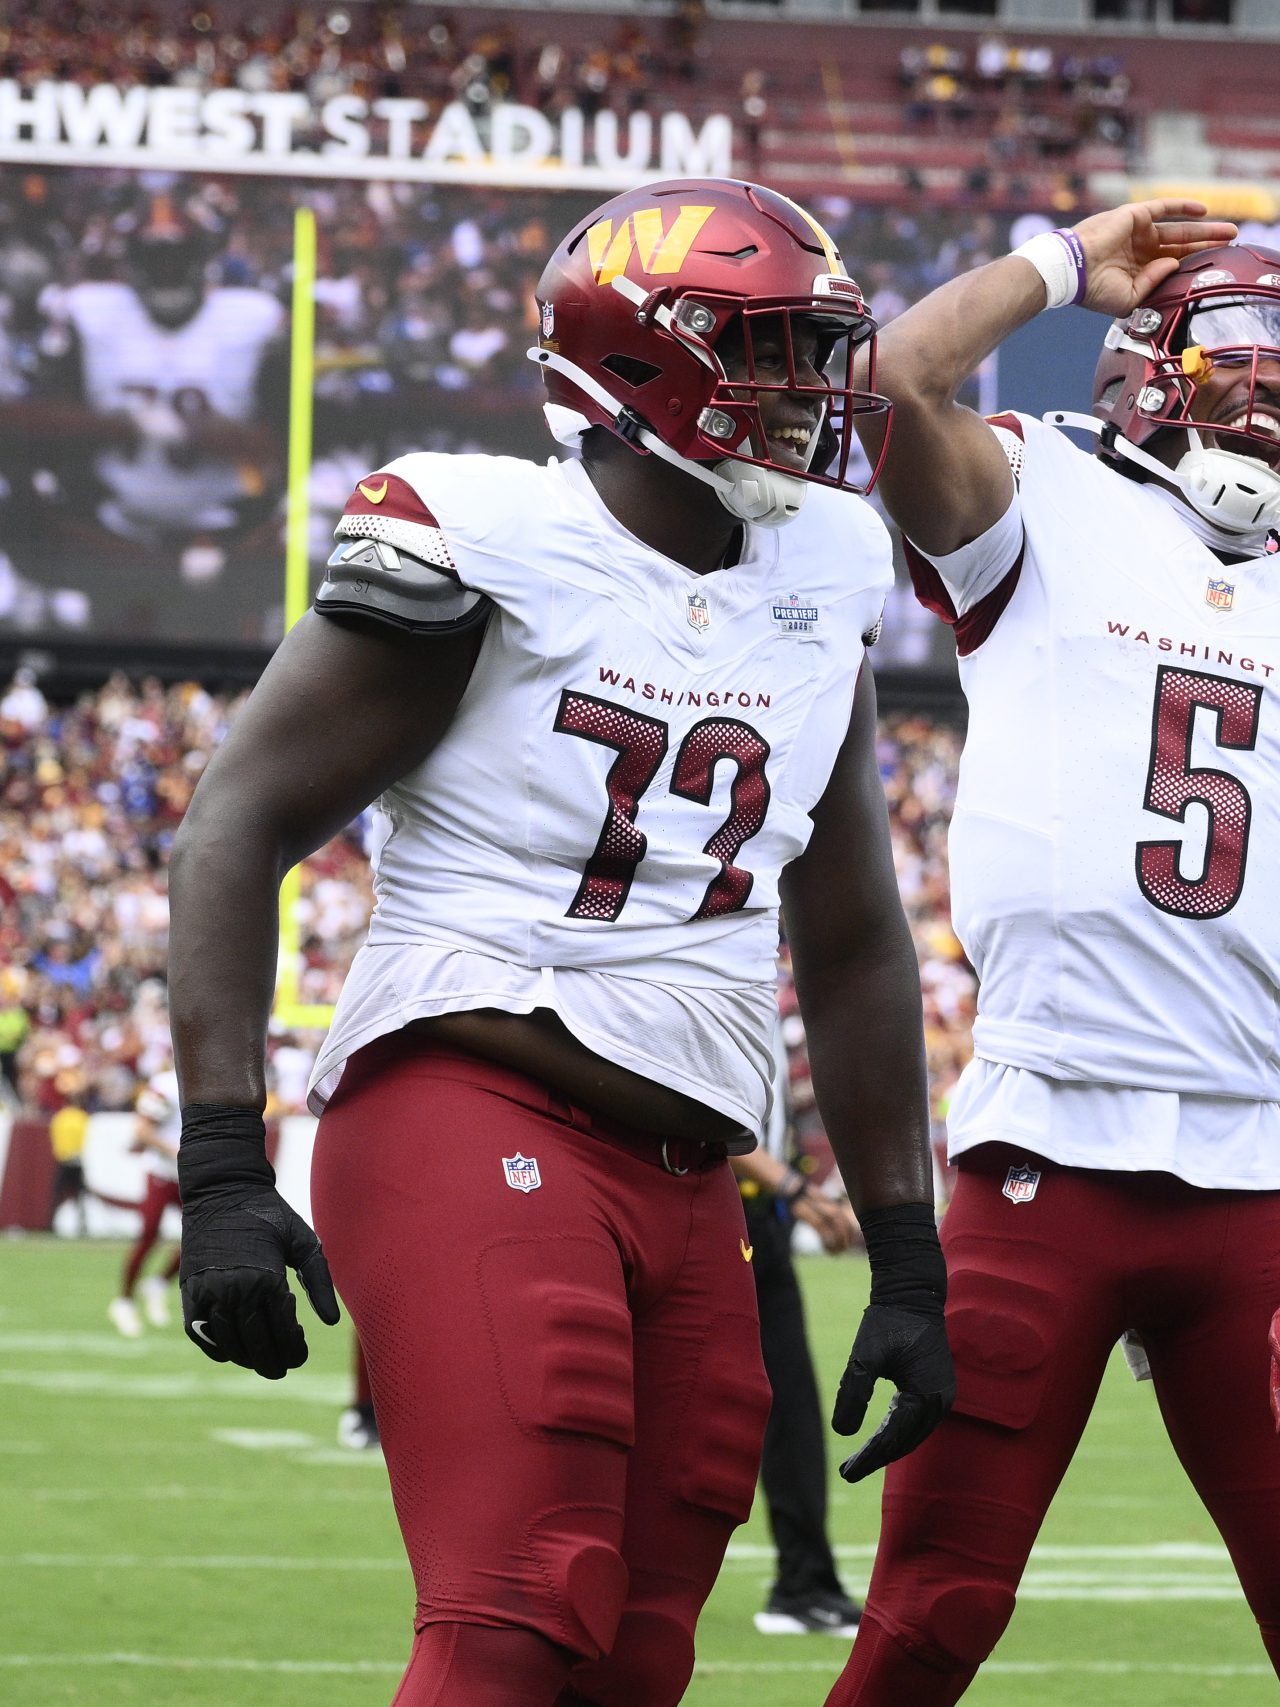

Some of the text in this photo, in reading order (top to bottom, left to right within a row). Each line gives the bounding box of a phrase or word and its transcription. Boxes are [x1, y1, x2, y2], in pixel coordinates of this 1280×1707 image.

[322, 95, 732, 176] STADIUM
[1208, 589, 1230, 607] NFL
[690, 607, 709, 625] NFL
[599, 666, 771, 708] WASHINGTON
[552, 688, 771, 923] 72
[1135, 664, 1263, 920] 5
[512, 1171, 536, 1186] NFL
[1008, 1181, 1030, 1197] NFL
